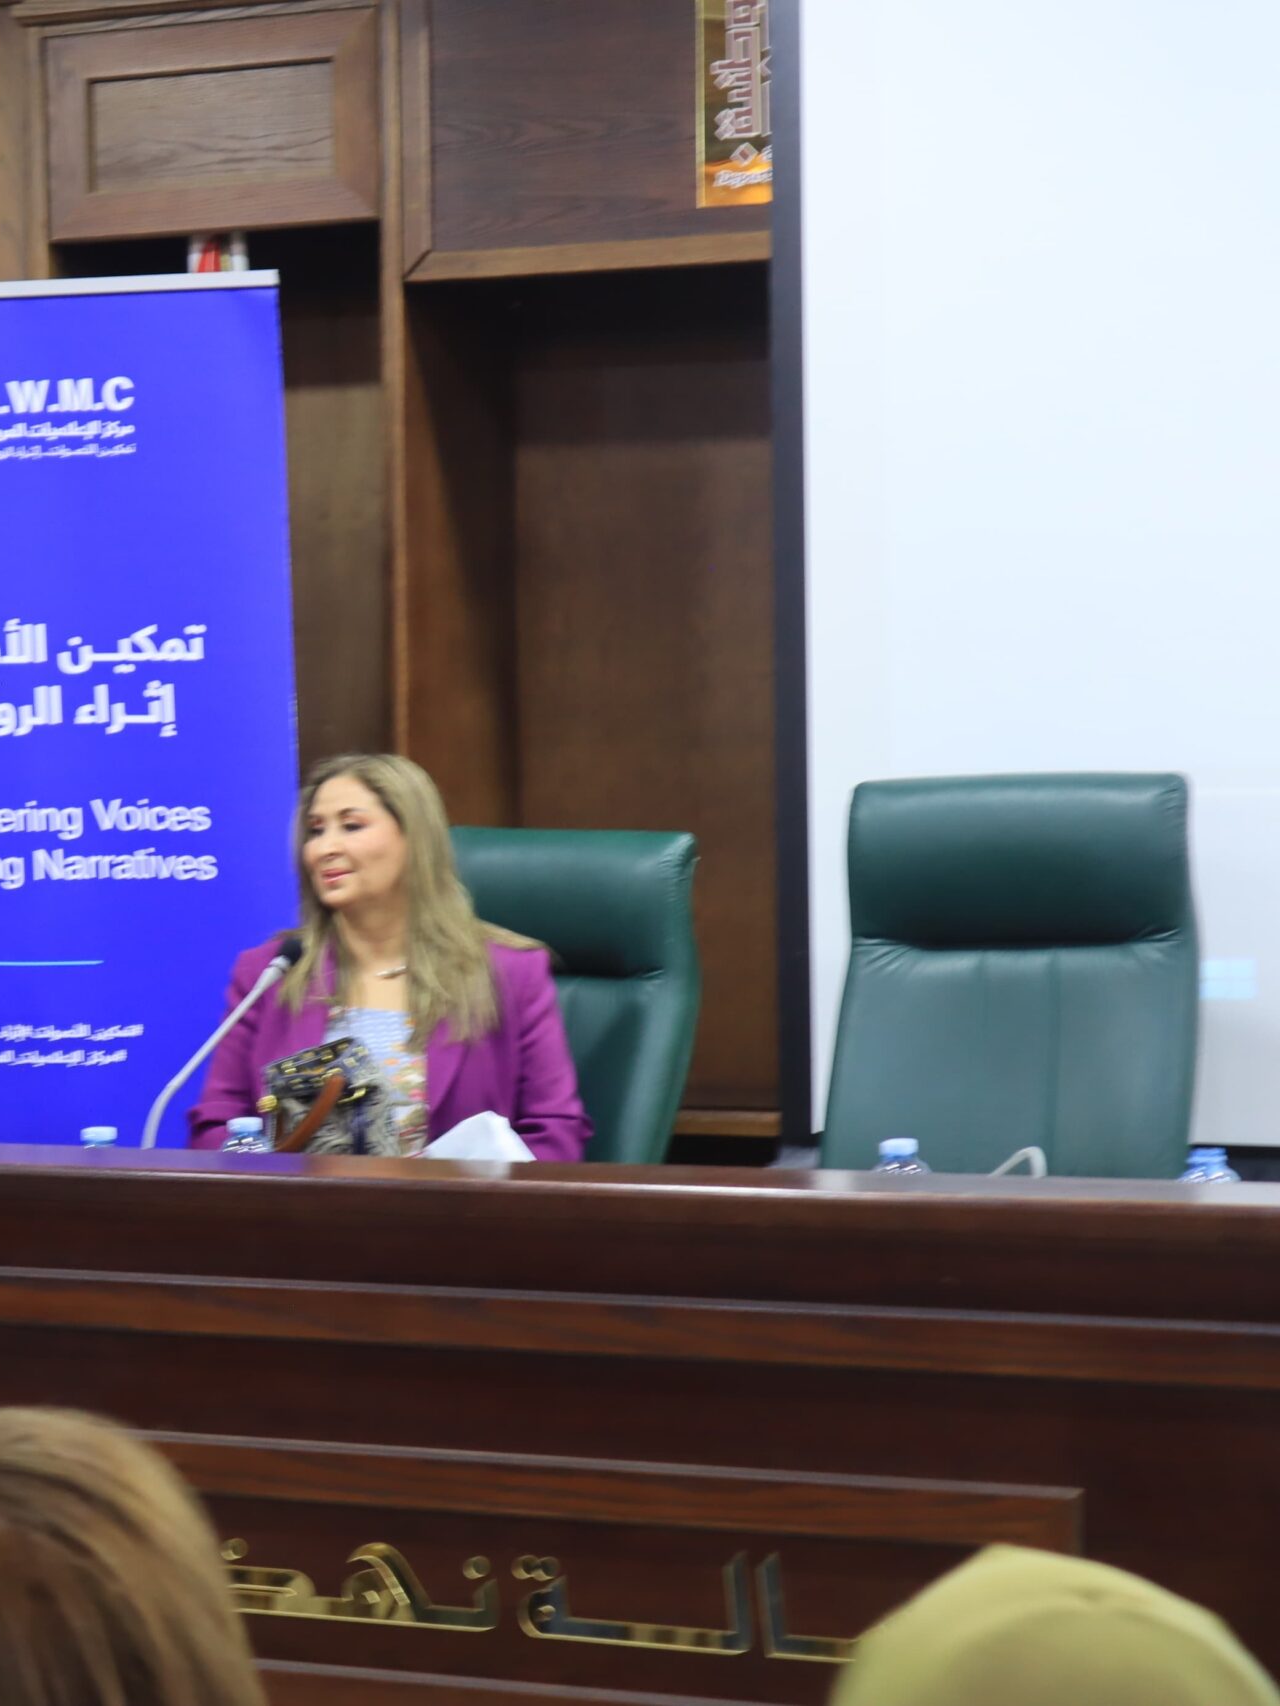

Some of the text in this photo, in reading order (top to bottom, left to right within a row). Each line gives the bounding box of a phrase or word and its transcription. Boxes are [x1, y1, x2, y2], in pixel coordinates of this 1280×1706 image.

[56, 624, 207, 674] تمكين
[74, 680, 178, 737] إثراء
[89, 798, 212, 832] Voices
[32, 847, 219, 881] Narratives
